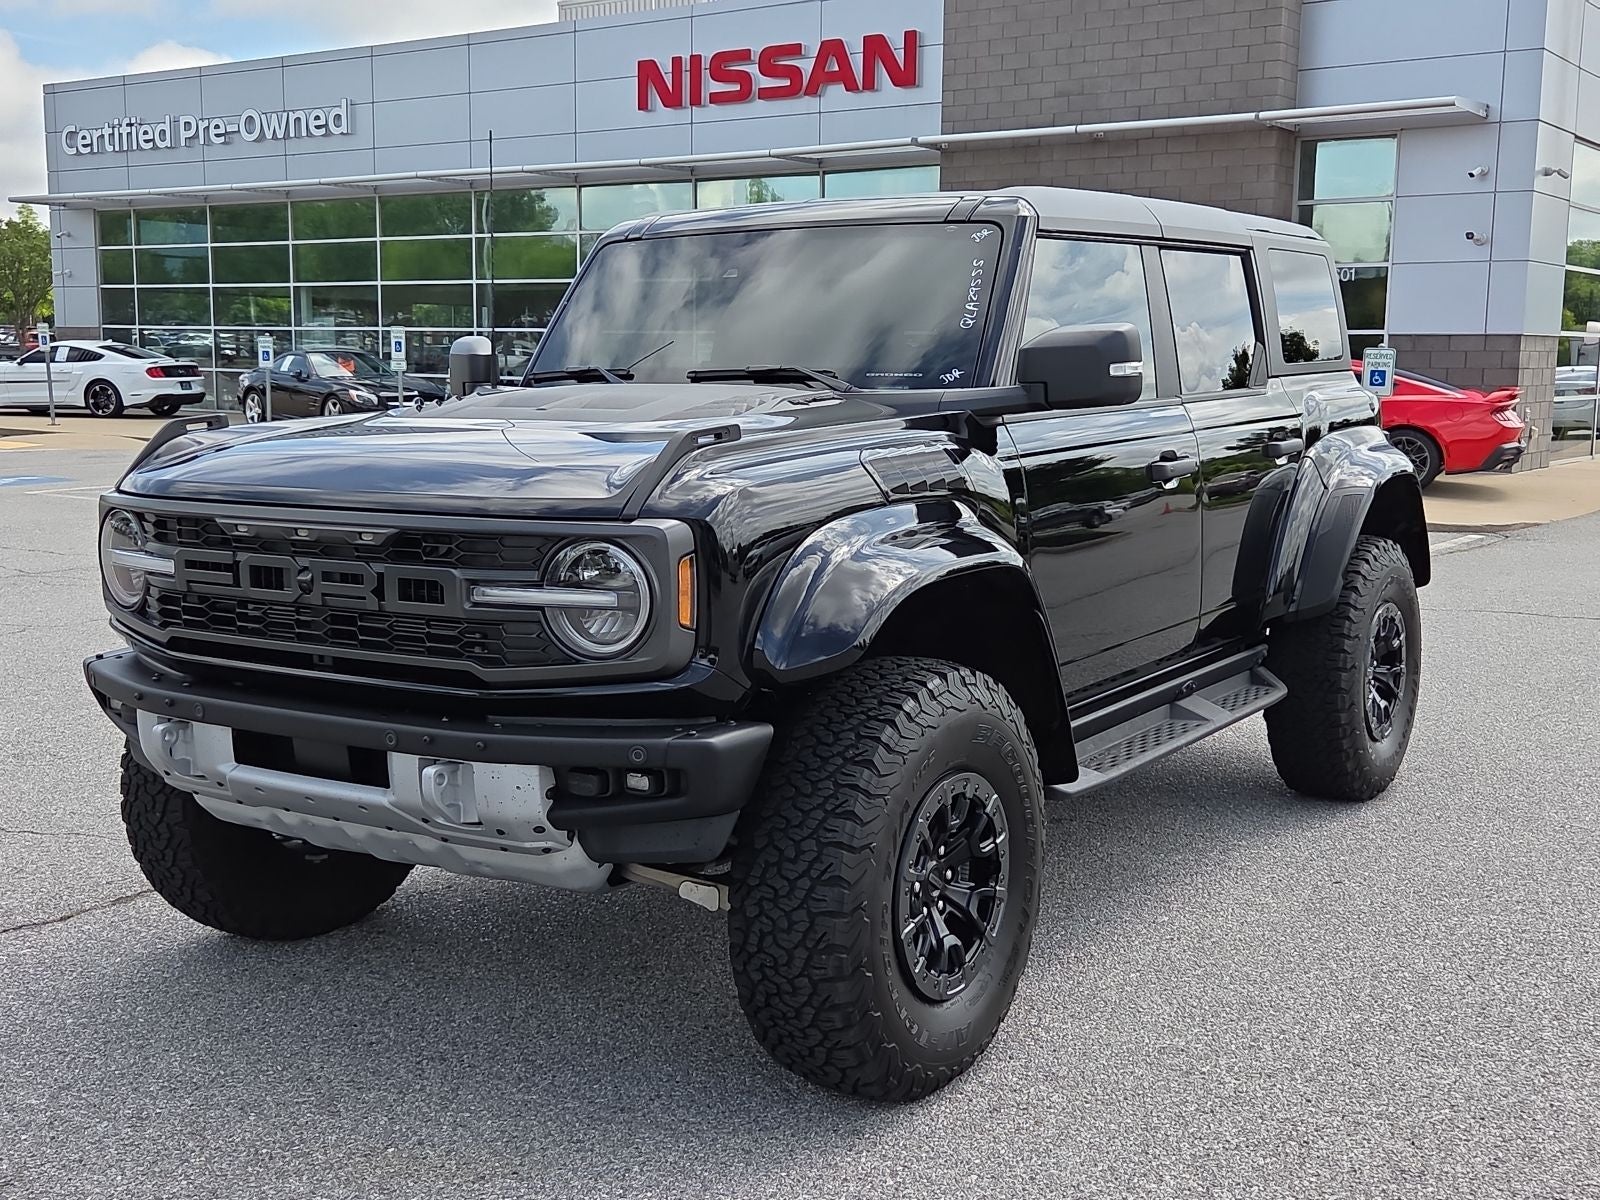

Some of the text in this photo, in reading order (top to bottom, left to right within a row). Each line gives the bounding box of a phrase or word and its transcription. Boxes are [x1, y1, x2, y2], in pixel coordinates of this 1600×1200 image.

[637, 29, 918, 111] NISSAN
[61, 98, 350, 155] Certified Pre-Owned
[939, 368, 965, 385] JDR
[1366, 352, 1393, 360] RESERVED
[175, 548, 462, 618] FORD
